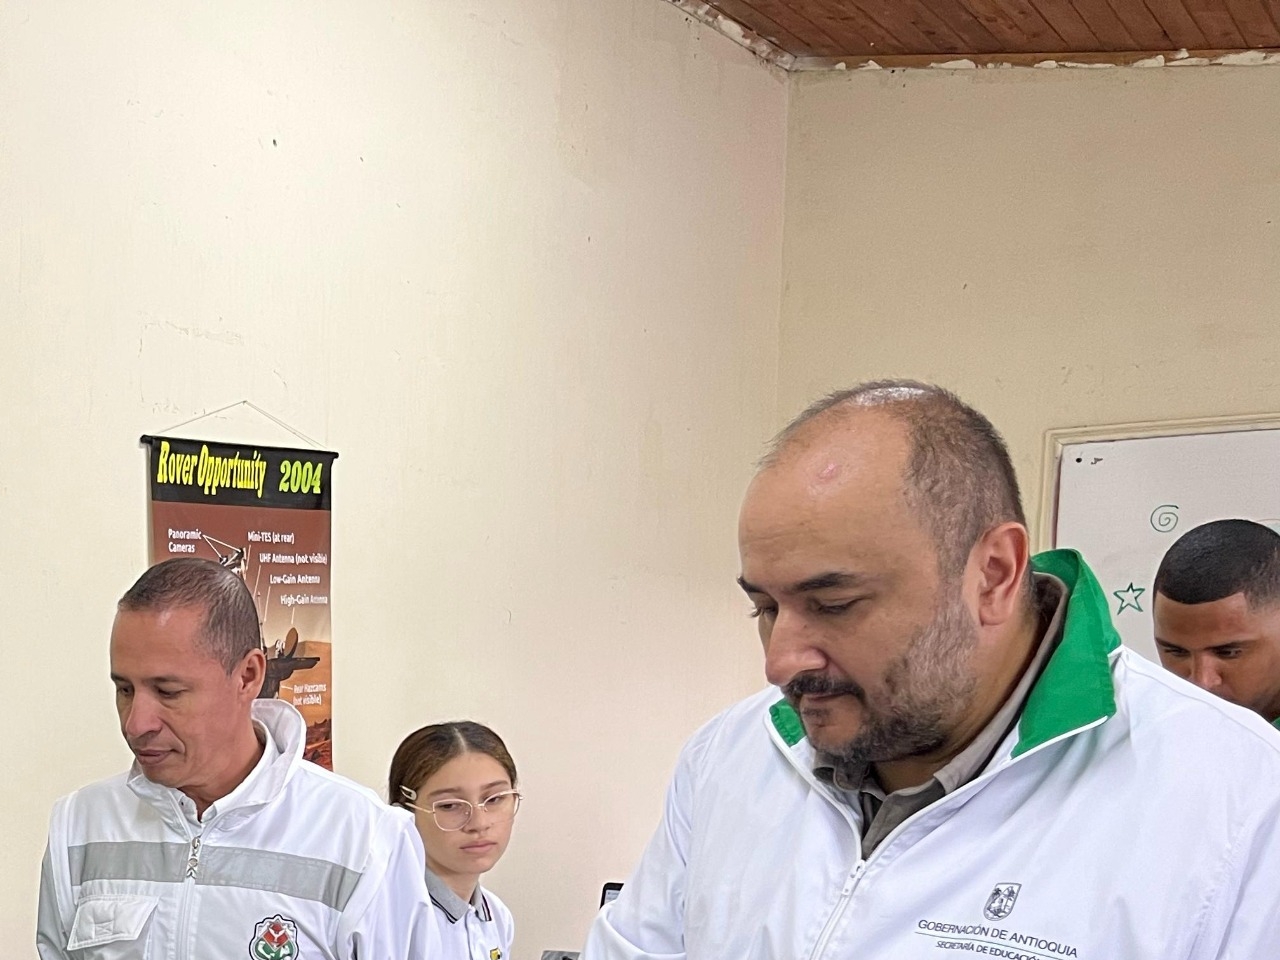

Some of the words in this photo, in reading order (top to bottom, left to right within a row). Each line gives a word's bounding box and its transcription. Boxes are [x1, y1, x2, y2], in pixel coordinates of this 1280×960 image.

[157, 441, 198, 485] Rover
[197, 444, 266, 498] Opportunity
[279, 460, 322, 494] 2004
[168, 528, 202, 540] Panoramic
[248, 532, 271, 542] Mini-TES
[272, 533, 280, 544] (at
[281, 533, 294, 544] rear)
[168, 542, 195, 553] Cameras
[259, 553, 271, 563] UHF
[272, 554, 294, 564] Antenna
[296, 554, 308, 565] (not
[270, 574, 296, 584] Low-Gain
[281, 594, 309, 606] High-Gain
[918, 919, 989, 937] GOBERNACIÓN
[990, 928, 1008, 940] DE
[1009, 933, 1078, 958] ANTIOQUIA
[935, 940, 975, 952] SECRETARÍA
[976, 944, 988, 954] DE
